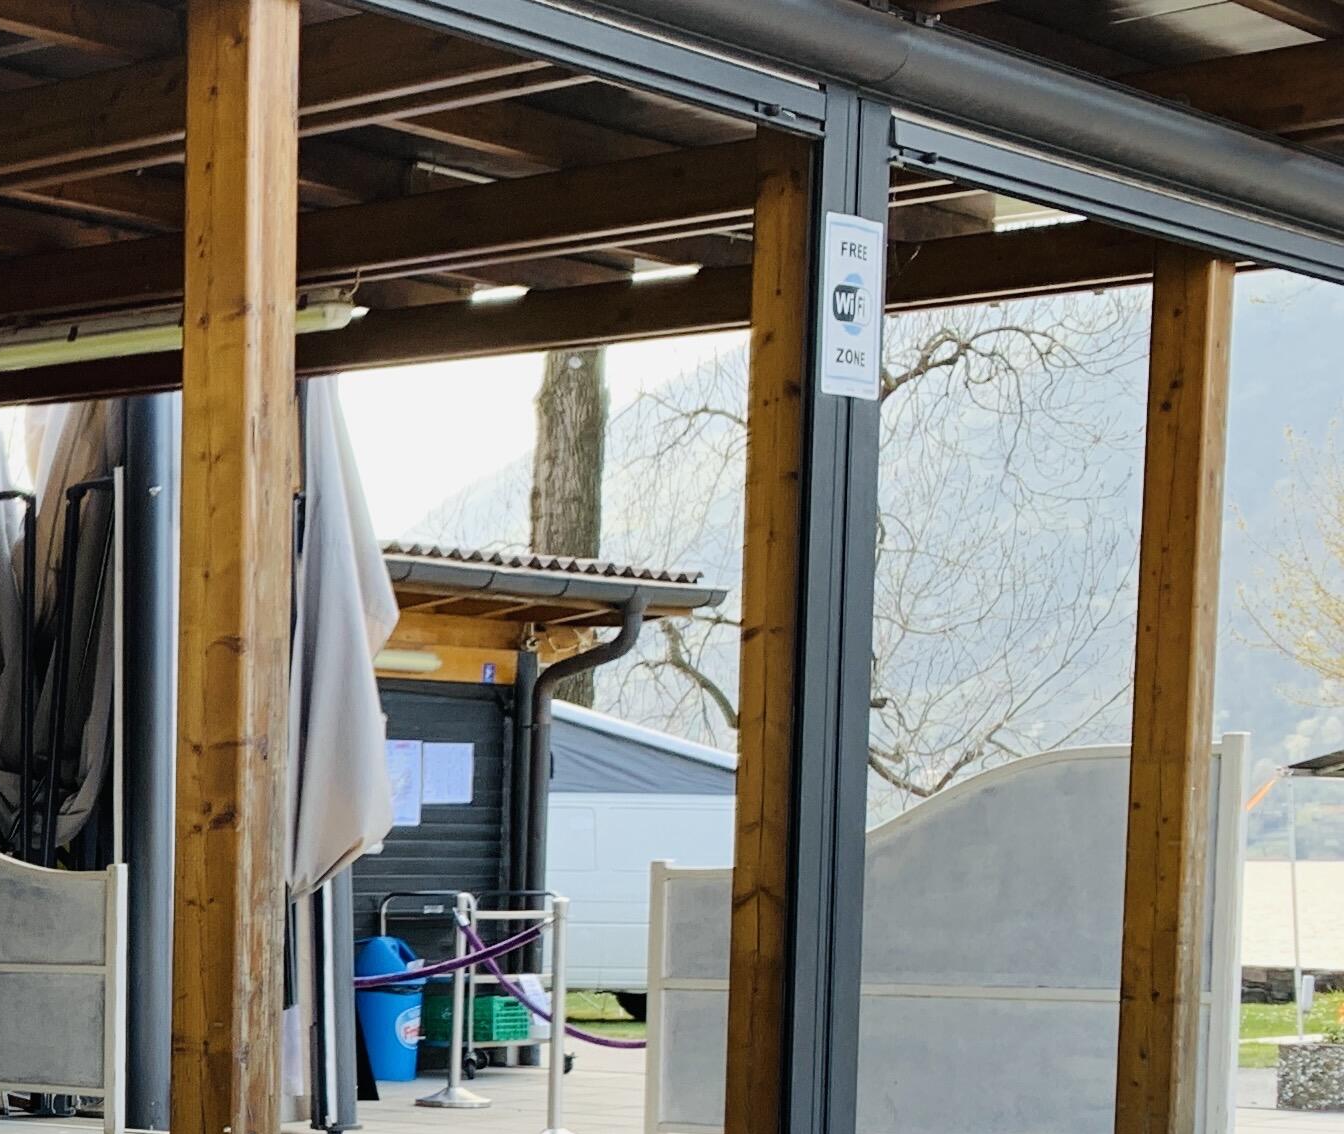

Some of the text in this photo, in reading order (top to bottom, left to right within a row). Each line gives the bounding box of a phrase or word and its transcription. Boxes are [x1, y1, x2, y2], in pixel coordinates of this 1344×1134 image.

[840, 241, 868, 261] FREE
[835, 291, 866, 318] WiFi
[835, 347, 866, 368] ZONE
